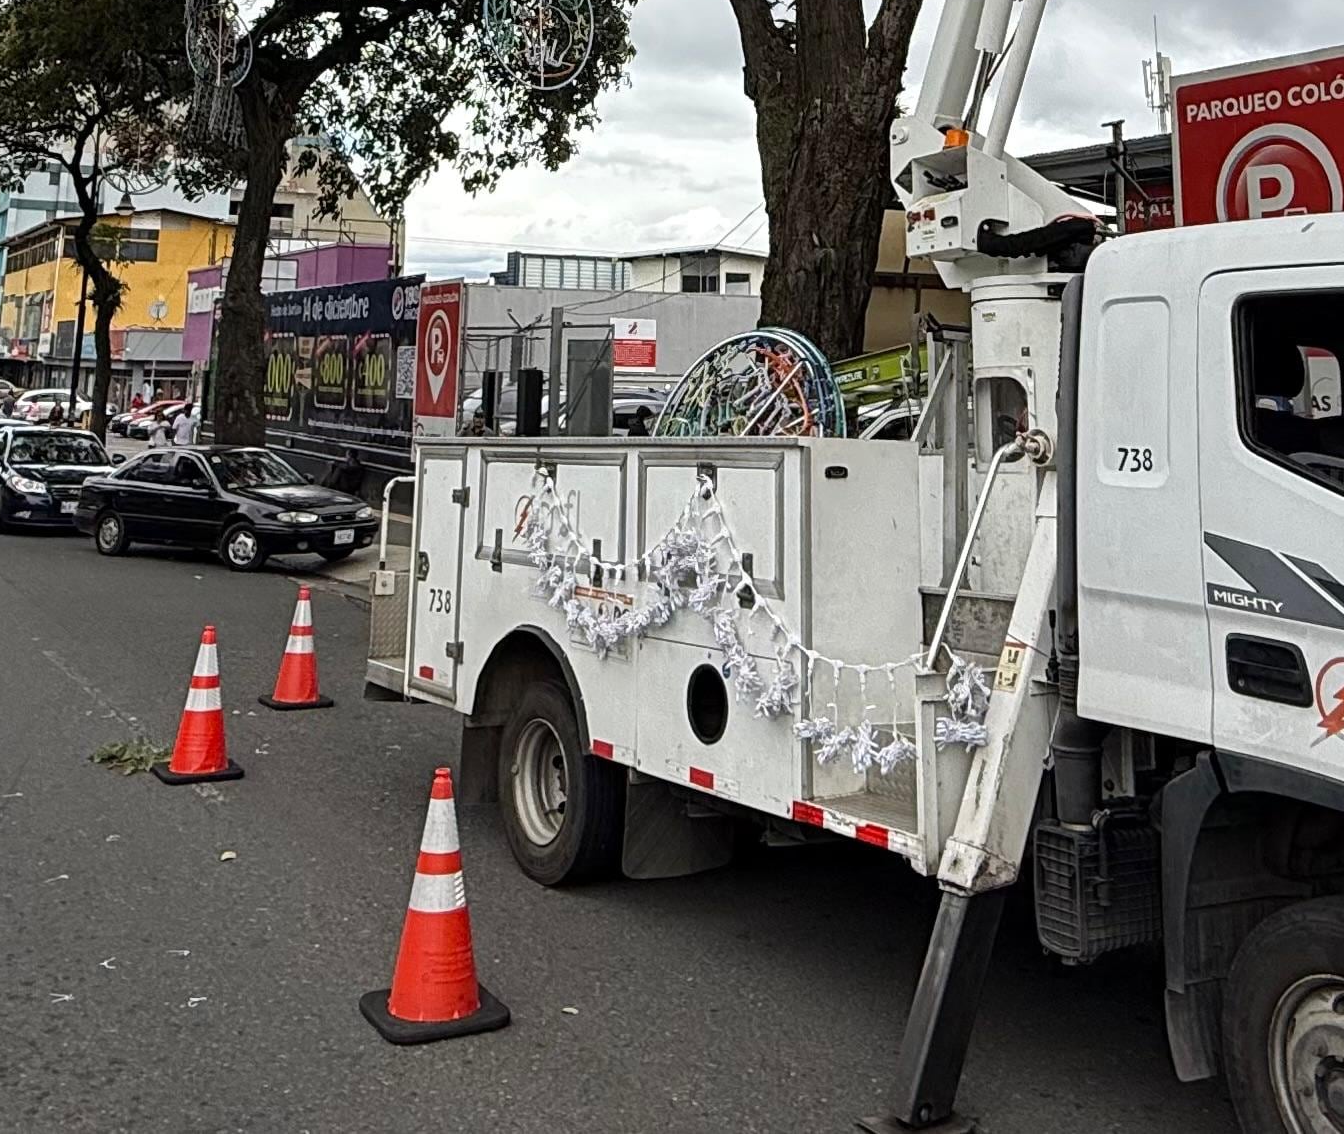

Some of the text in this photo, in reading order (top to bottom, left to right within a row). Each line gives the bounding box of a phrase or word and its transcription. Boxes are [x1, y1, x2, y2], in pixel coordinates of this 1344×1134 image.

[1186, 90, 1282, 123] PARQUEO
[1247, 163, 1295, 219] P
[312, 296, 323, 321] de
[324, 294, 369, 321] diciembre
[264, 354, 291, 393] .000
[1118, 447, 1153, 472] 738
[429, 588, 451, 614] 738
[1213, 589, 1283, 613] MIGHTY
